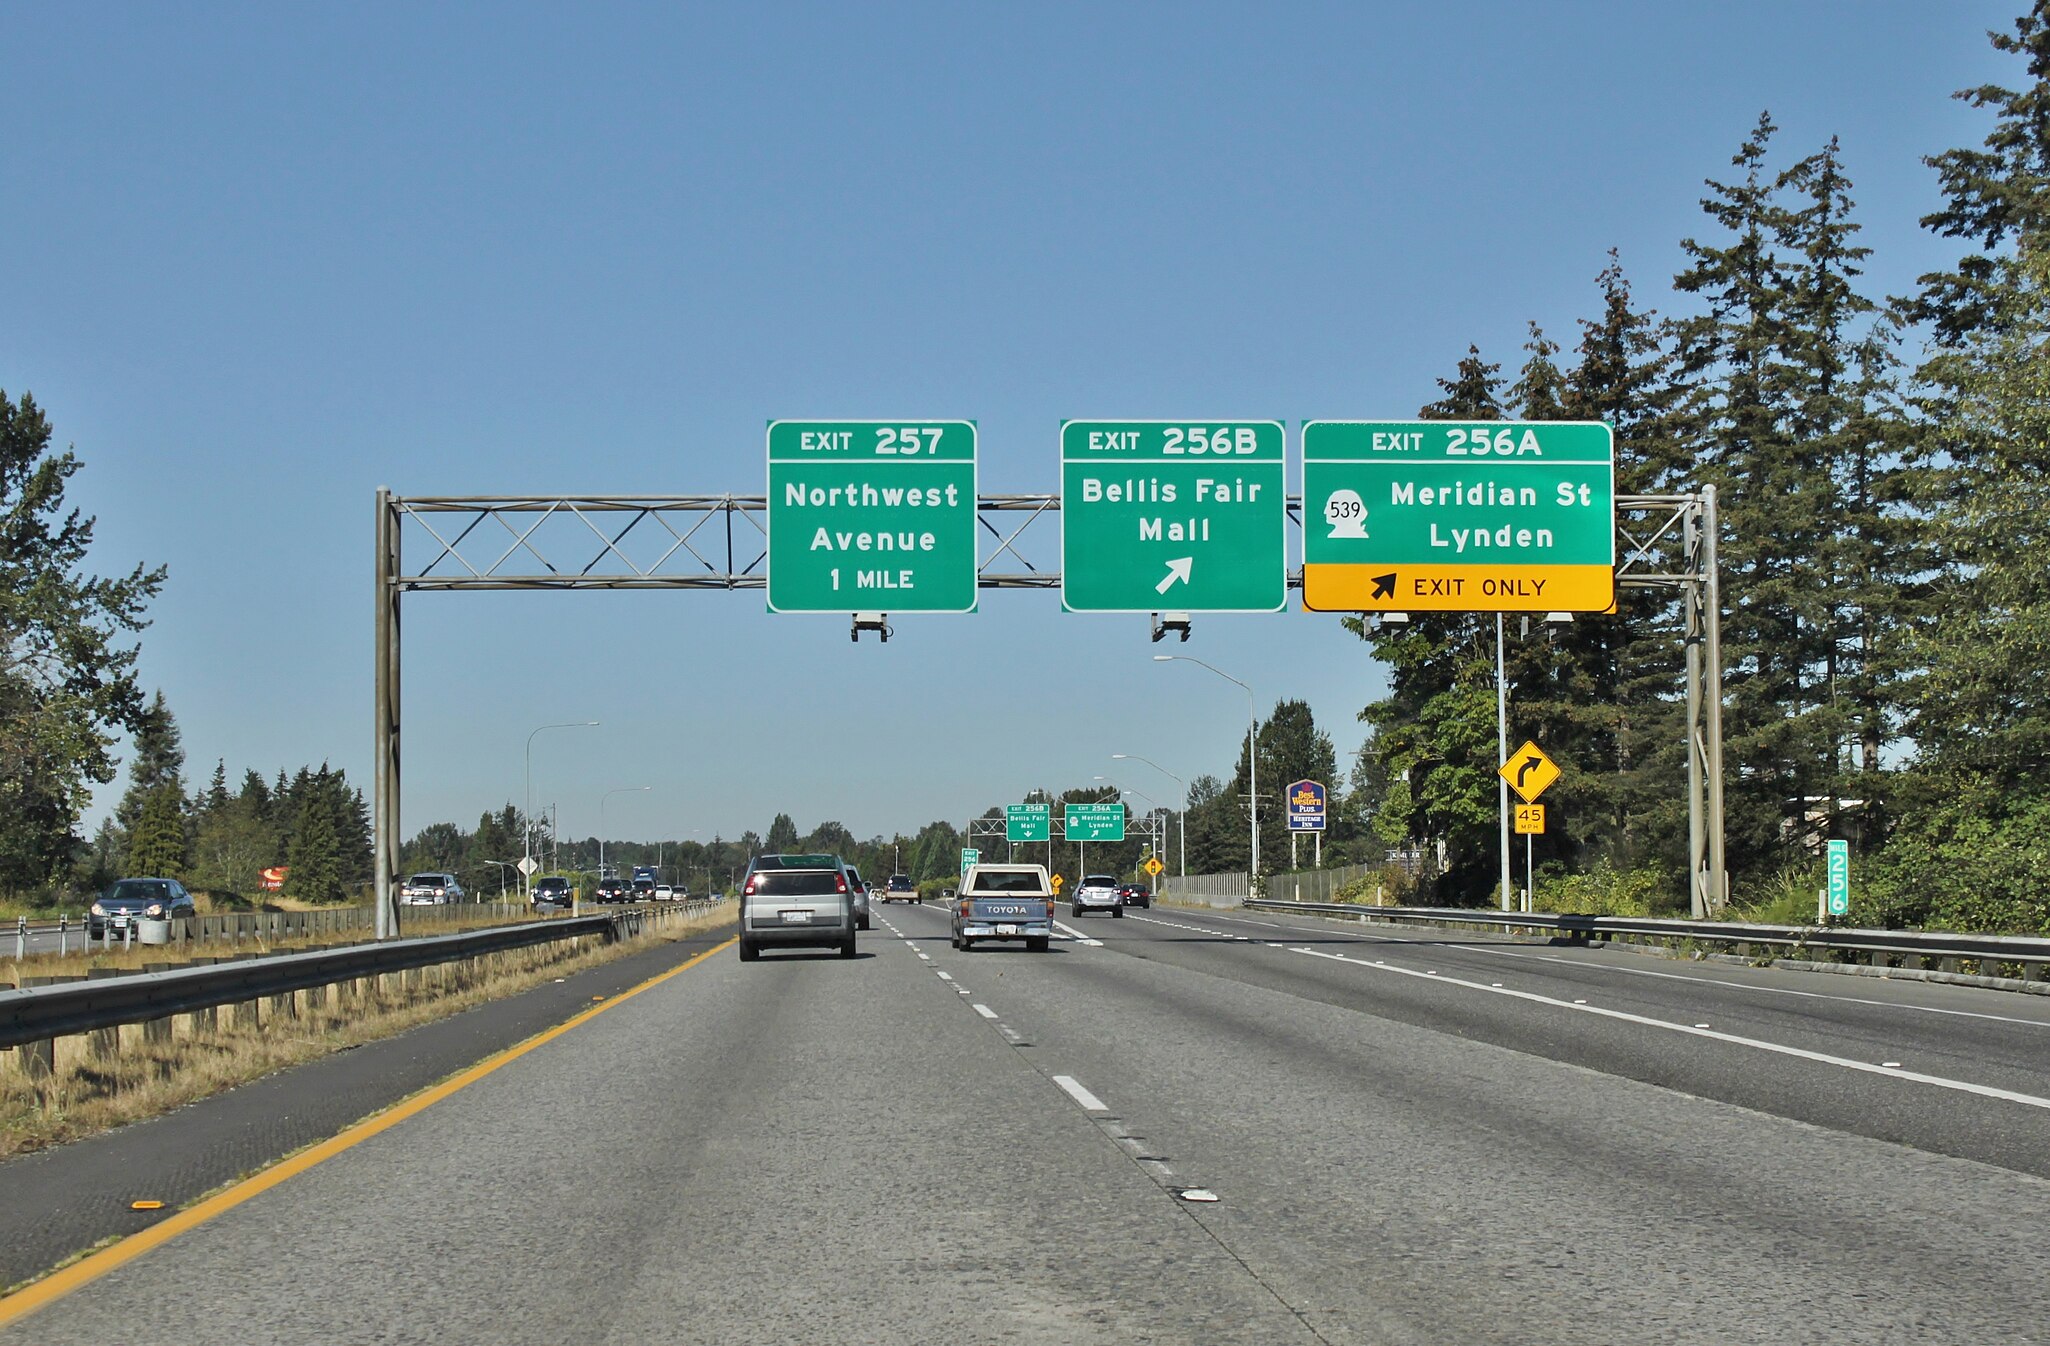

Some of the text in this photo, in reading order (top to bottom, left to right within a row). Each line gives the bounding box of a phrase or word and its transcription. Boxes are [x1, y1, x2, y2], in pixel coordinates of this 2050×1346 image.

[801, 428, 944, 455] EXIT 257
[1088, 428, 1258, 455] EXIT 256B
[1372, 429, 1543, 455] EXIT 256A
[785, 483, 958, 507] Northwest
[1082, 478, 1262, 503] Bellis Fair
[1391, 481, 1591, 507] Meridian St
[1330, 501, 1361, 518] 539
[810, 527, 936, 552] Avenue
[1139, 517, 1210, 541] Mall
[1430, 523, 1553, 553] Lynden
[830, 569, 914, 590] 1 MILE
[1414, 579, 1546, 596] EXIT ONLY
[1292, 797, 1321, 806] Western
[1518, 809, 1541, 821] 45
[1832, 855, 1845, 911] 256
[987, 906, 1027, 914] TOYOTA
